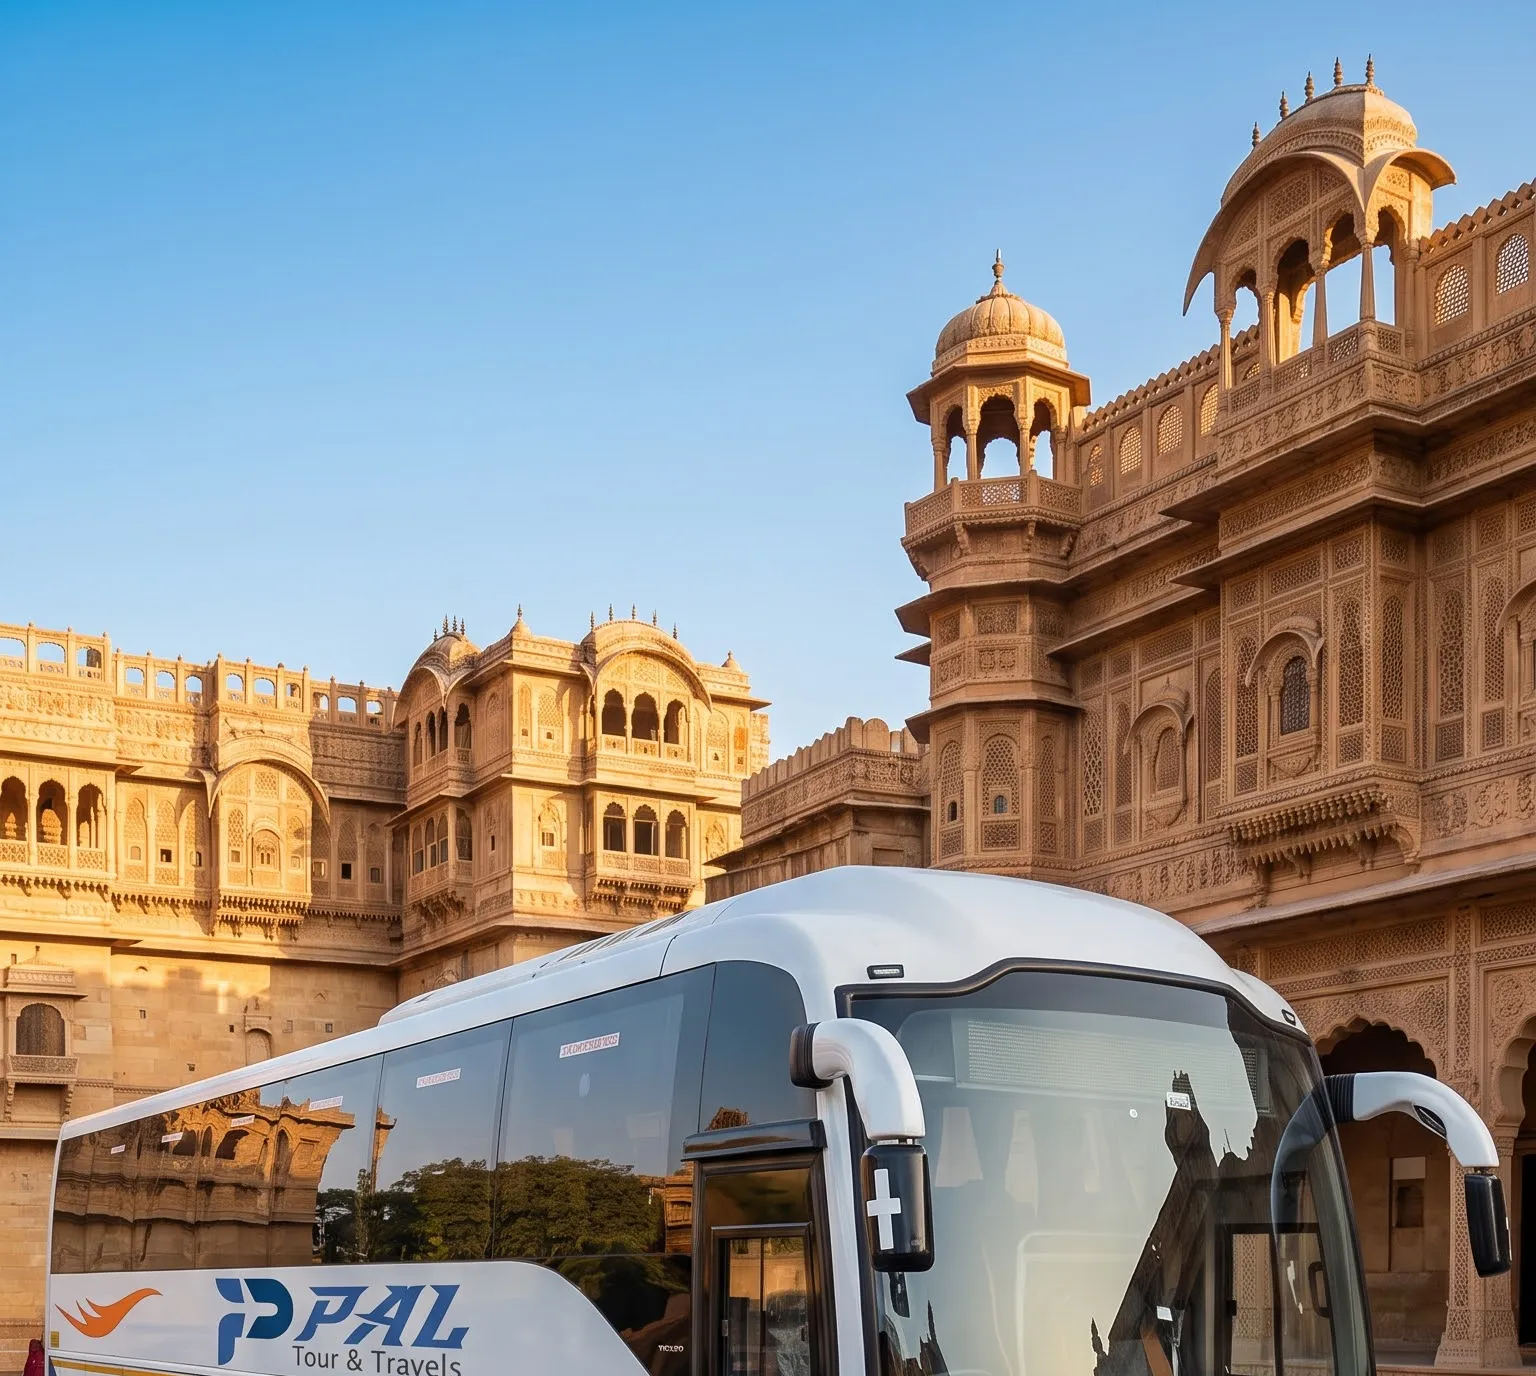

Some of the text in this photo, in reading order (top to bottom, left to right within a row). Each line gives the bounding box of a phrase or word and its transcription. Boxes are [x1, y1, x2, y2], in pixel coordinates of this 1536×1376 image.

[294, 1285, 470, 1349] PAL
[292, 1346, 339, 1369] Tour
[346, 1348, 363, 1372] &
